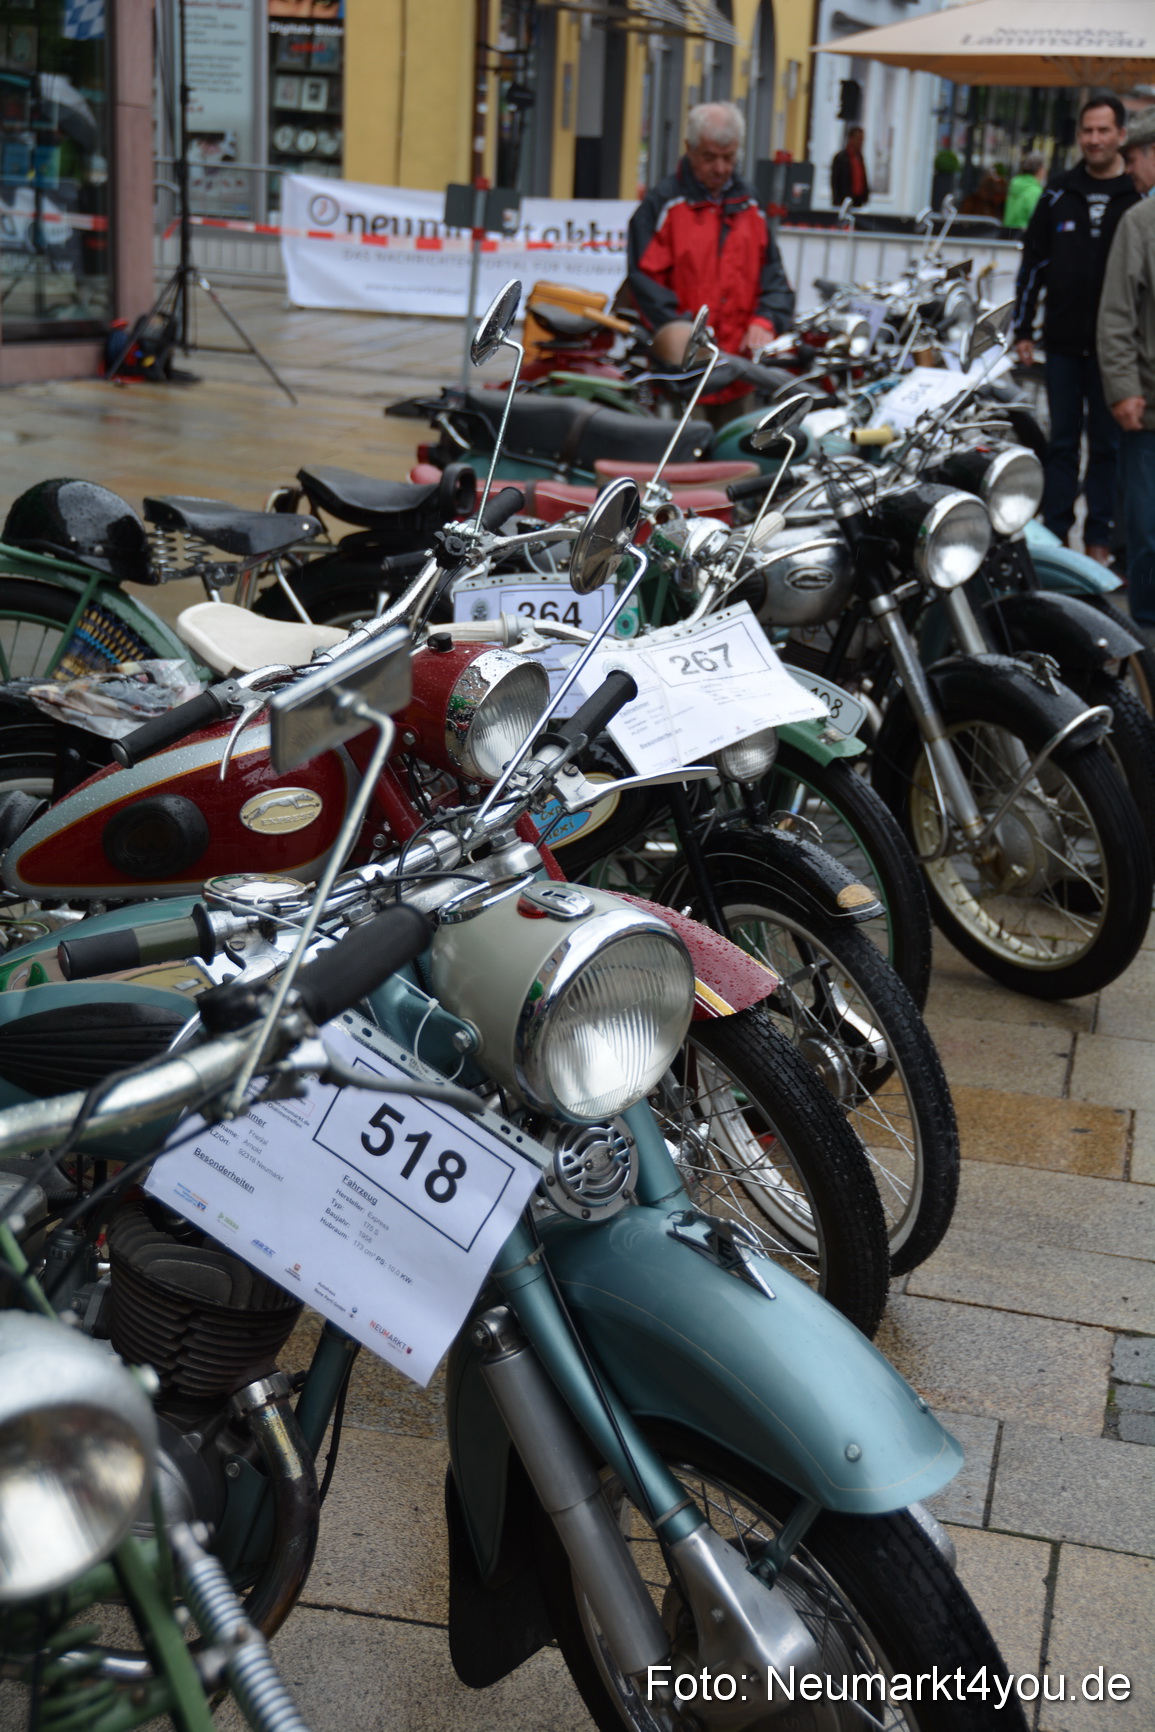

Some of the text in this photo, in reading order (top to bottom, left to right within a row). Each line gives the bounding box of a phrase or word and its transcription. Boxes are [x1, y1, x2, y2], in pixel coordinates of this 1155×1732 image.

[668, 642, 733, 676] 267
[261, 810, 315, 826] EXPRESS
[243, 1139, 262, 1155] Arnold
[360, 1102, 468, 1204] 518
[193, 1148, 255, 1194] Besonderheiten
[256, 1160, 284, 1182] Neumarkt
[330, 1198, 344, 1211] Typ:
[341, 1175, 379, 1206] Fahrzeug
[325, 1208, 351, 1229] Baujahr:
[335, 1189, 390, 1231] Hersteller: Express
[320, 1217, 349, 1240] Hubraum:
[375, 1256, 387, 1267] PS:
[400, 1274, 414, 1286] KW:
[370, 1321, 407, 1350] NEUMARKT
